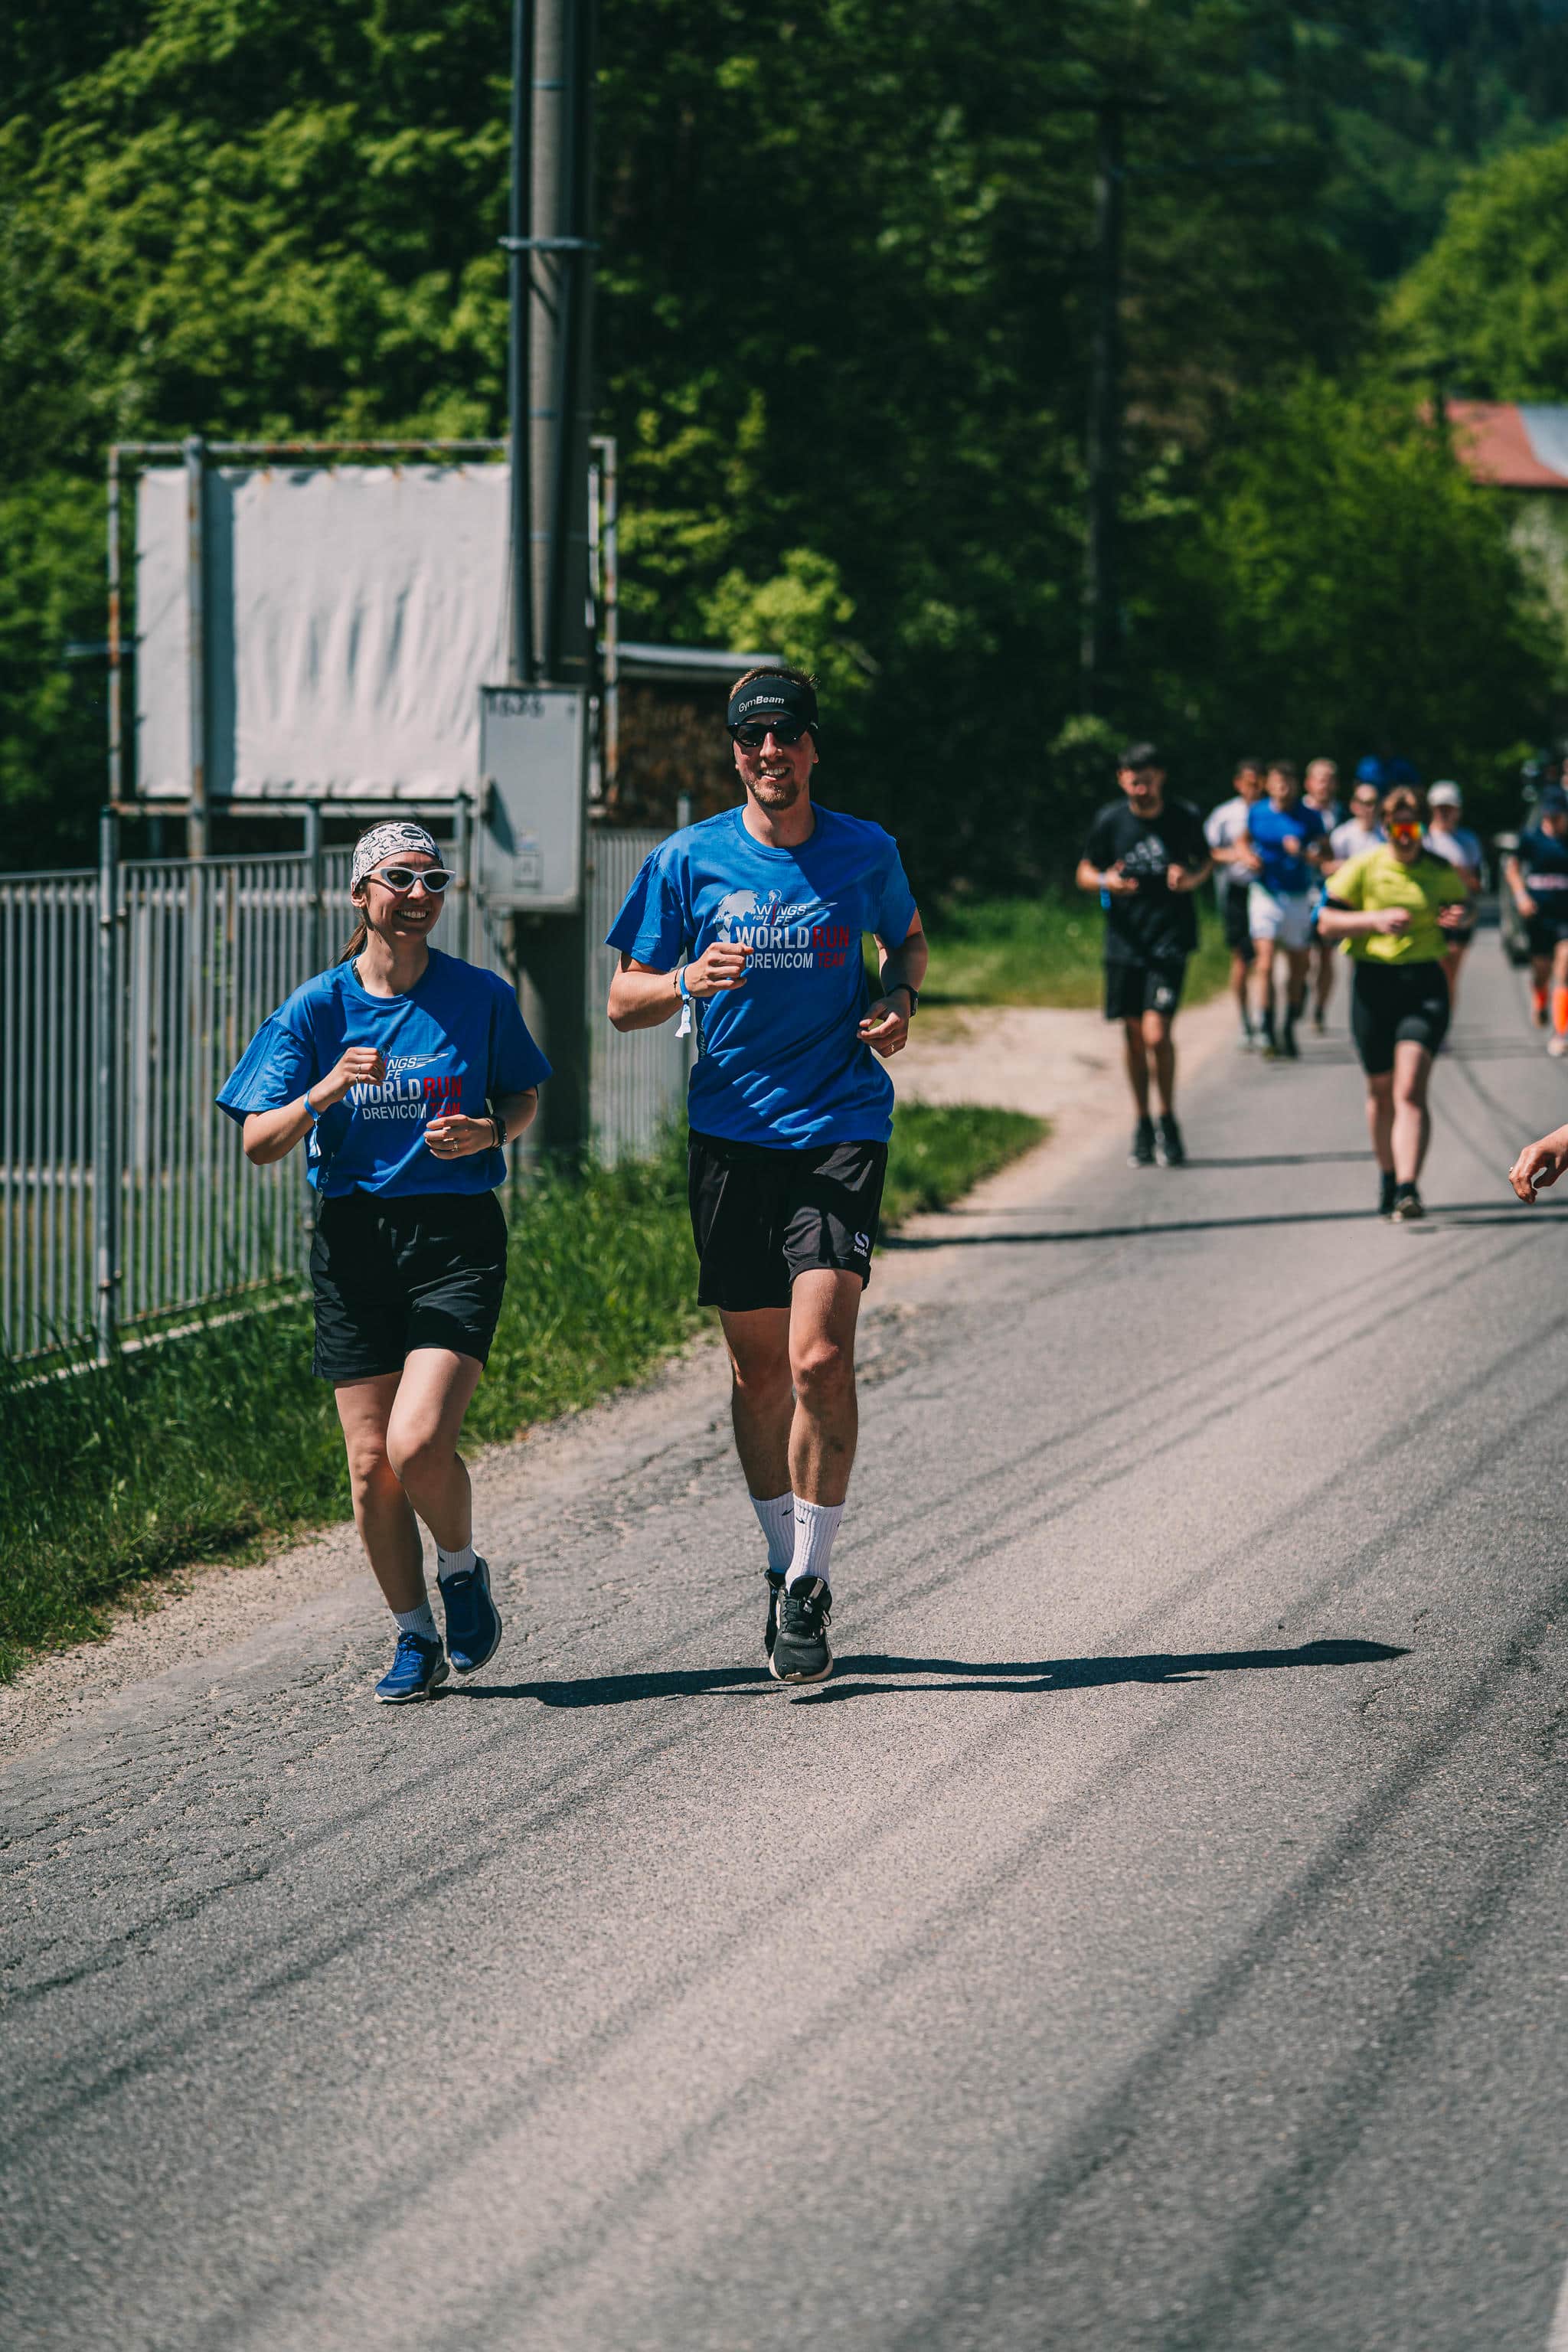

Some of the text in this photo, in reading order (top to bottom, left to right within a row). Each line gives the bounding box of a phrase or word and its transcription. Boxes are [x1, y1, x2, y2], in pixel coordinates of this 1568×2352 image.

[738, 695, 785, 713] GymBeam
[756, 903, 808, 916] WINGS
[763, 915, 792, 927] LIFE
[736, 925, 850, 949] WORLD RUN
[746, 952, 813, 969] DREVICOM
[384, 1056, 418, 1070] INGS
[350, 1076, 462, 1106] WORLD RUN
[362, 1102, 461, 1120] DREVICOM TEAM
